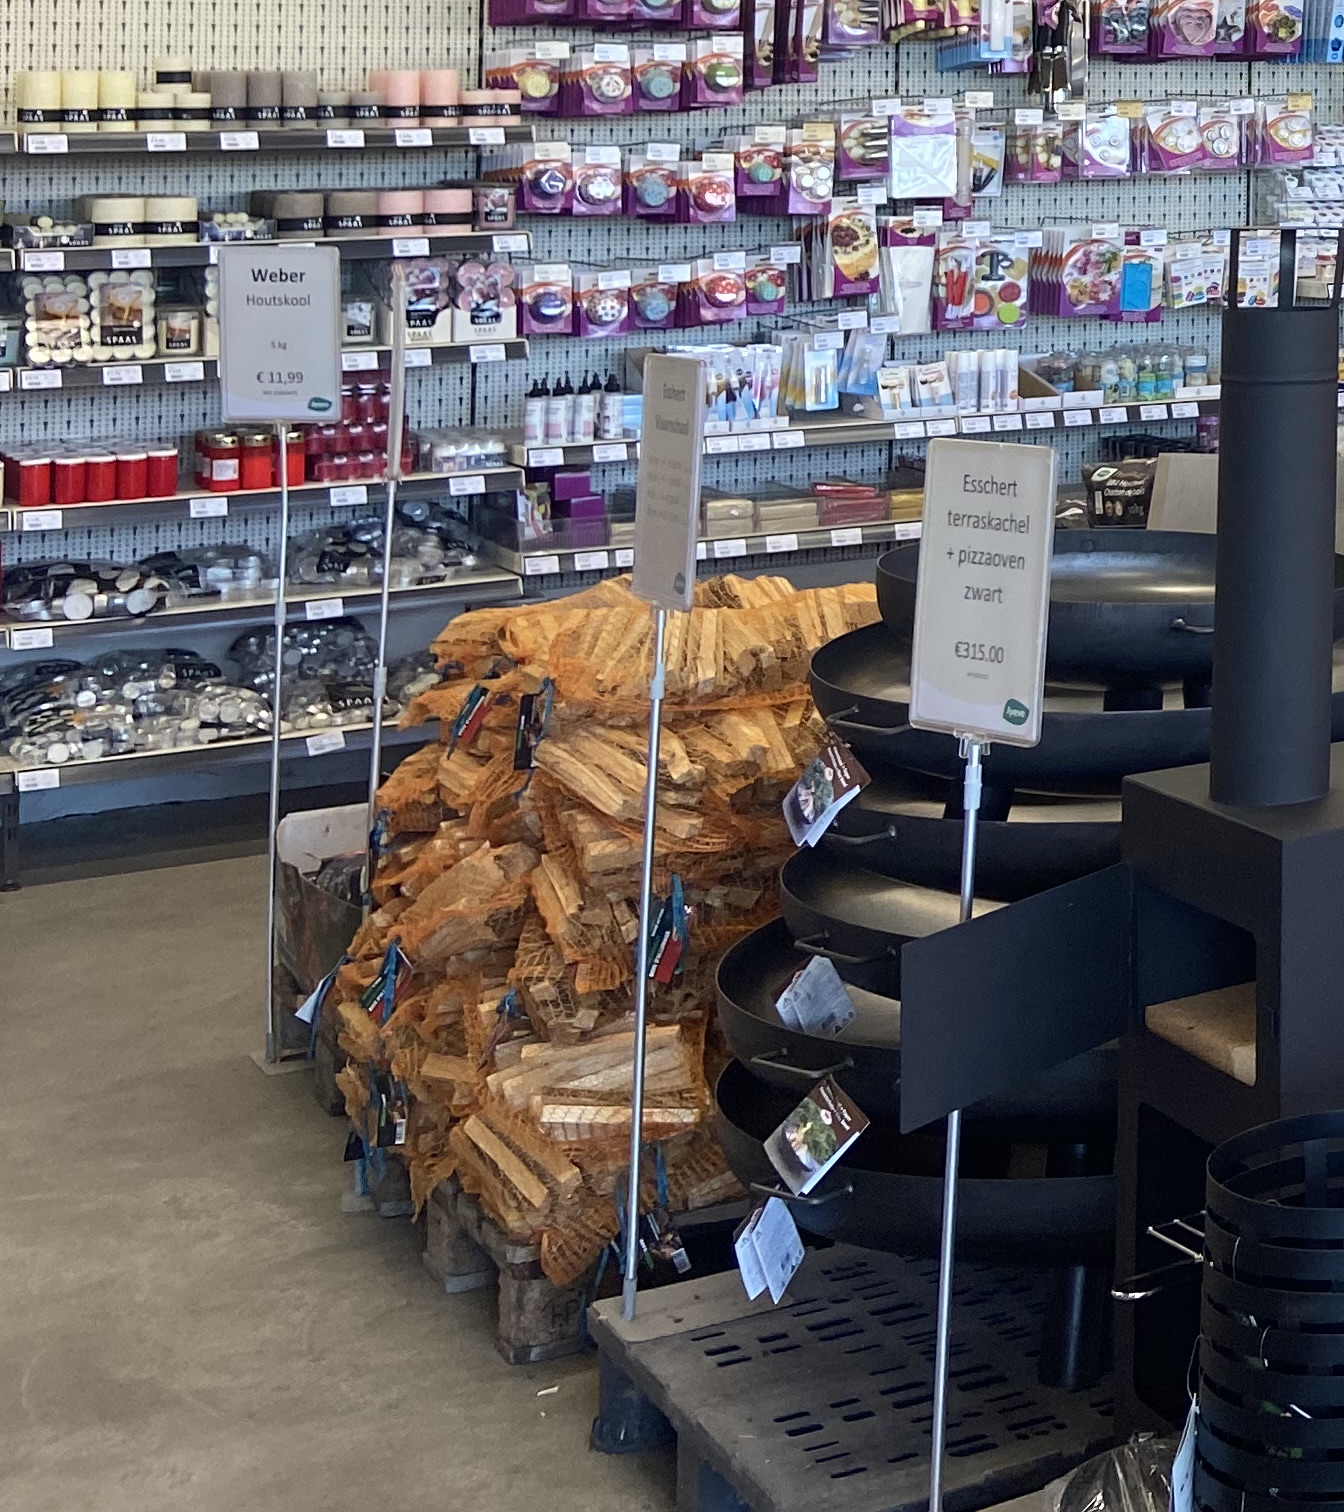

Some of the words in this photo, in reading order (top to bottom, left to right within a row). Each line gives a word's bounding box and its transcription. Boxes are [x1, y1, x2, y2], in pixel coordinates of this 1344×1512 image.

[251, 267, 306, 283] Weber
[246, 294, 311, 307] Houtskool
[277, 340, 287, 351] kg
[257, 372, 265, 383] €
[268, 371, 304, 385] 11,99
[963, 473, 1018, 498] Esschert
[947, 509, 1031, 535] terraskachel
[957, 545, 1026, 571] pizzaoven
[964, 583, 1003, 605] zwart
[954, 640, 1005, 665] €315.00
